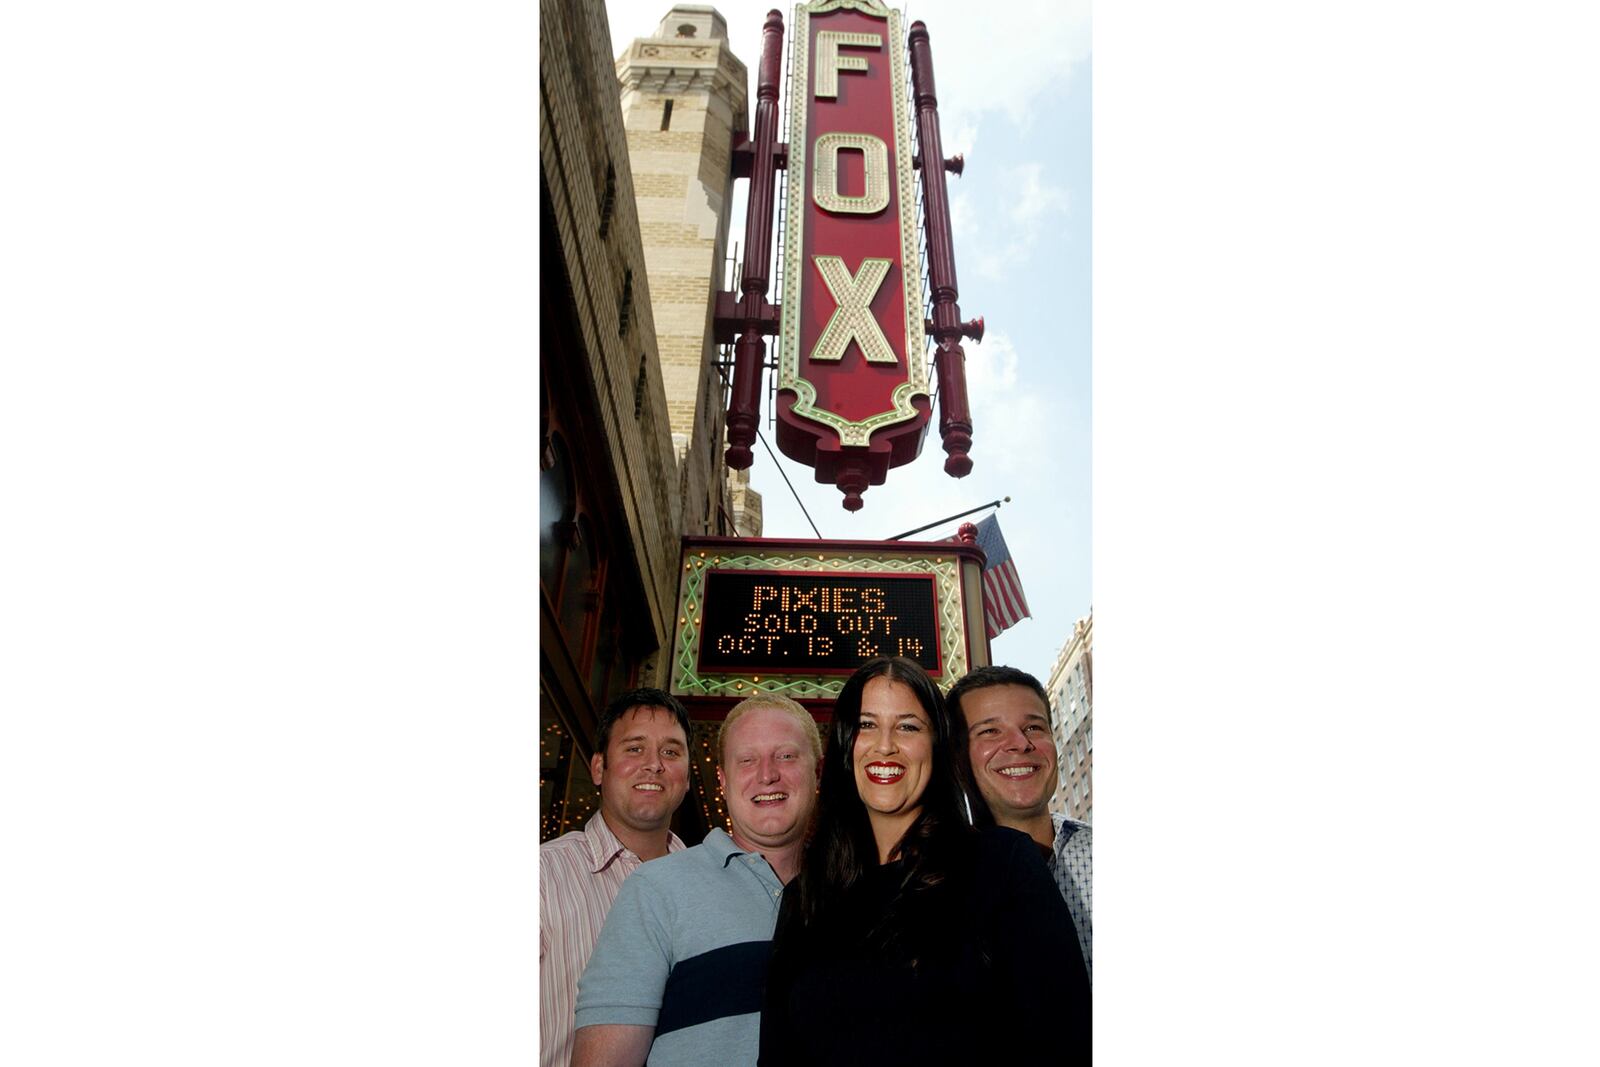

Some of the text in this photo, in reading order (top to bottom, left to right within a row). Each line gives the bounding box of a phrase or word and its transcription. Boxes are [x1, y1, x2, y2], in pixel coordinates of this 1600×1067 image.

[809, 30, 898, 363] FOX
[753, 585, 886, 613] PIXIES
[743, 613, 898, 635] SOLD OUT
[717, 634, 924, 657] OCT. 13 & 14
